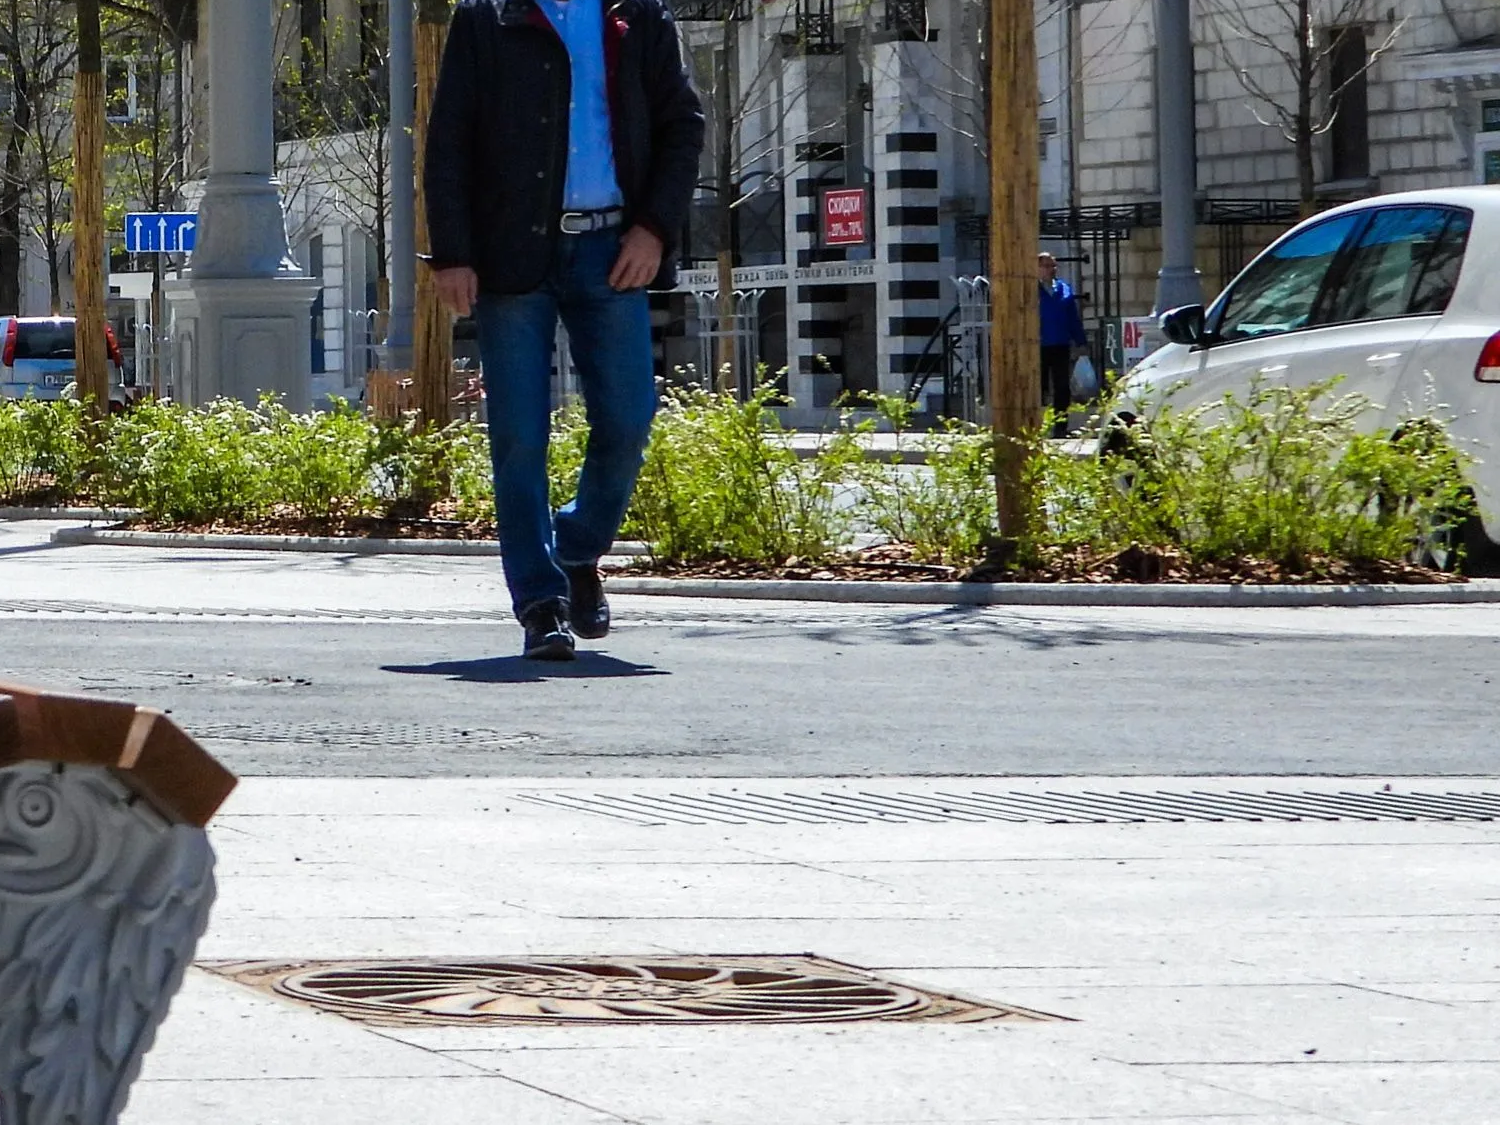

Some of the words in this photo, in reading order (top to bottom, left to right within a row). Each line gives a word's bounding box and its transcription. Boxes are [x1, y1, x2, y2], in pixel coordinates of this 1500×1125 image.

[828, 196, 860, 216] СКИДКИ
[688, 275, 718, 285] ЖЕНСКА
[733, 272, 760, 284] ДЕЖДА
[765, 269, 789, 281] ОБУВЬ
